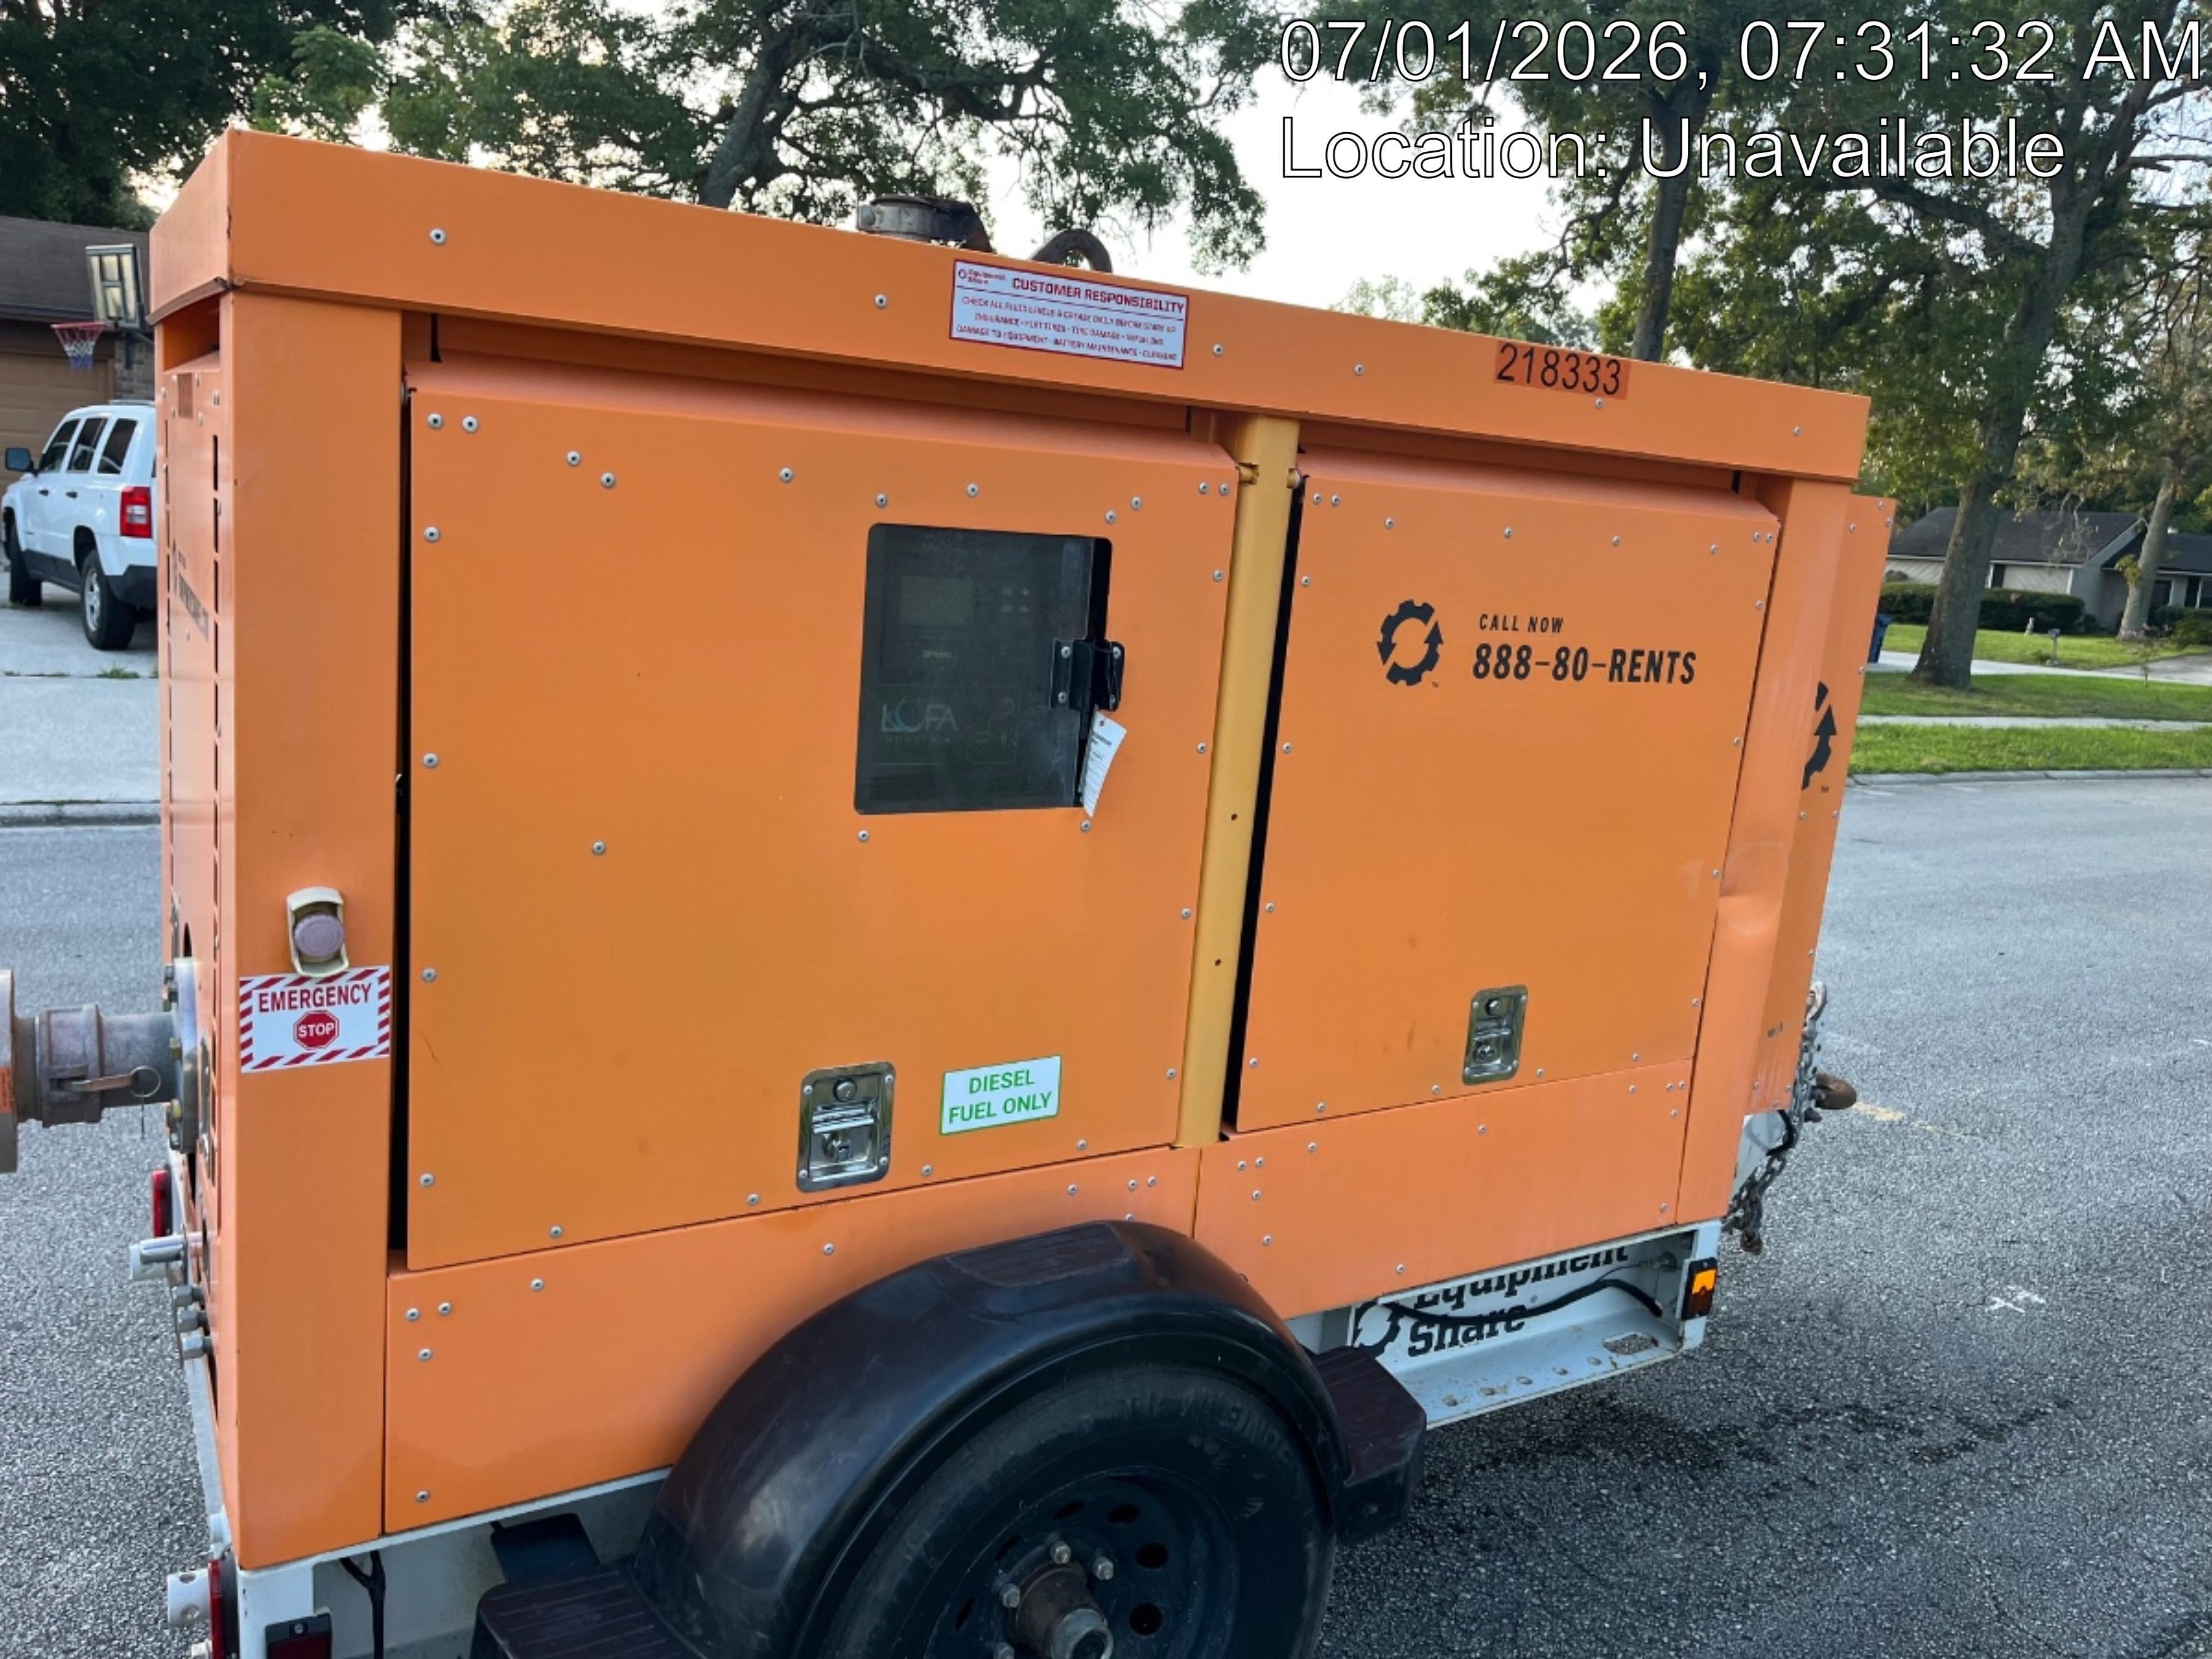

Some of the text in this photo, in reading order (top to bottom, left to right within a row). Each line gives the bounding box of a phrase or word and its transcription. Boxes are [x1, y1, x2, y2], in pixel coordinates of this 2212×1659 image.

[1012, 278, 1184, 313] CUSTOMER RESPONSIBILITY
[1497, 343, 1622, 395] 218333
[1479, 613, 1564, 633] CALL NOW
[1473, 643, 1696, 684] 888-80-RENTS
[258, 983, 372, 1013] EMERGENCY
[297, 1022, 335, 1038] STOP
[968, 1069, 1035, 1094] DIESEL
[949, 1091, 1053, 1124] FUEL ONLY
[1408, 1305, 1526, 1357] Share
